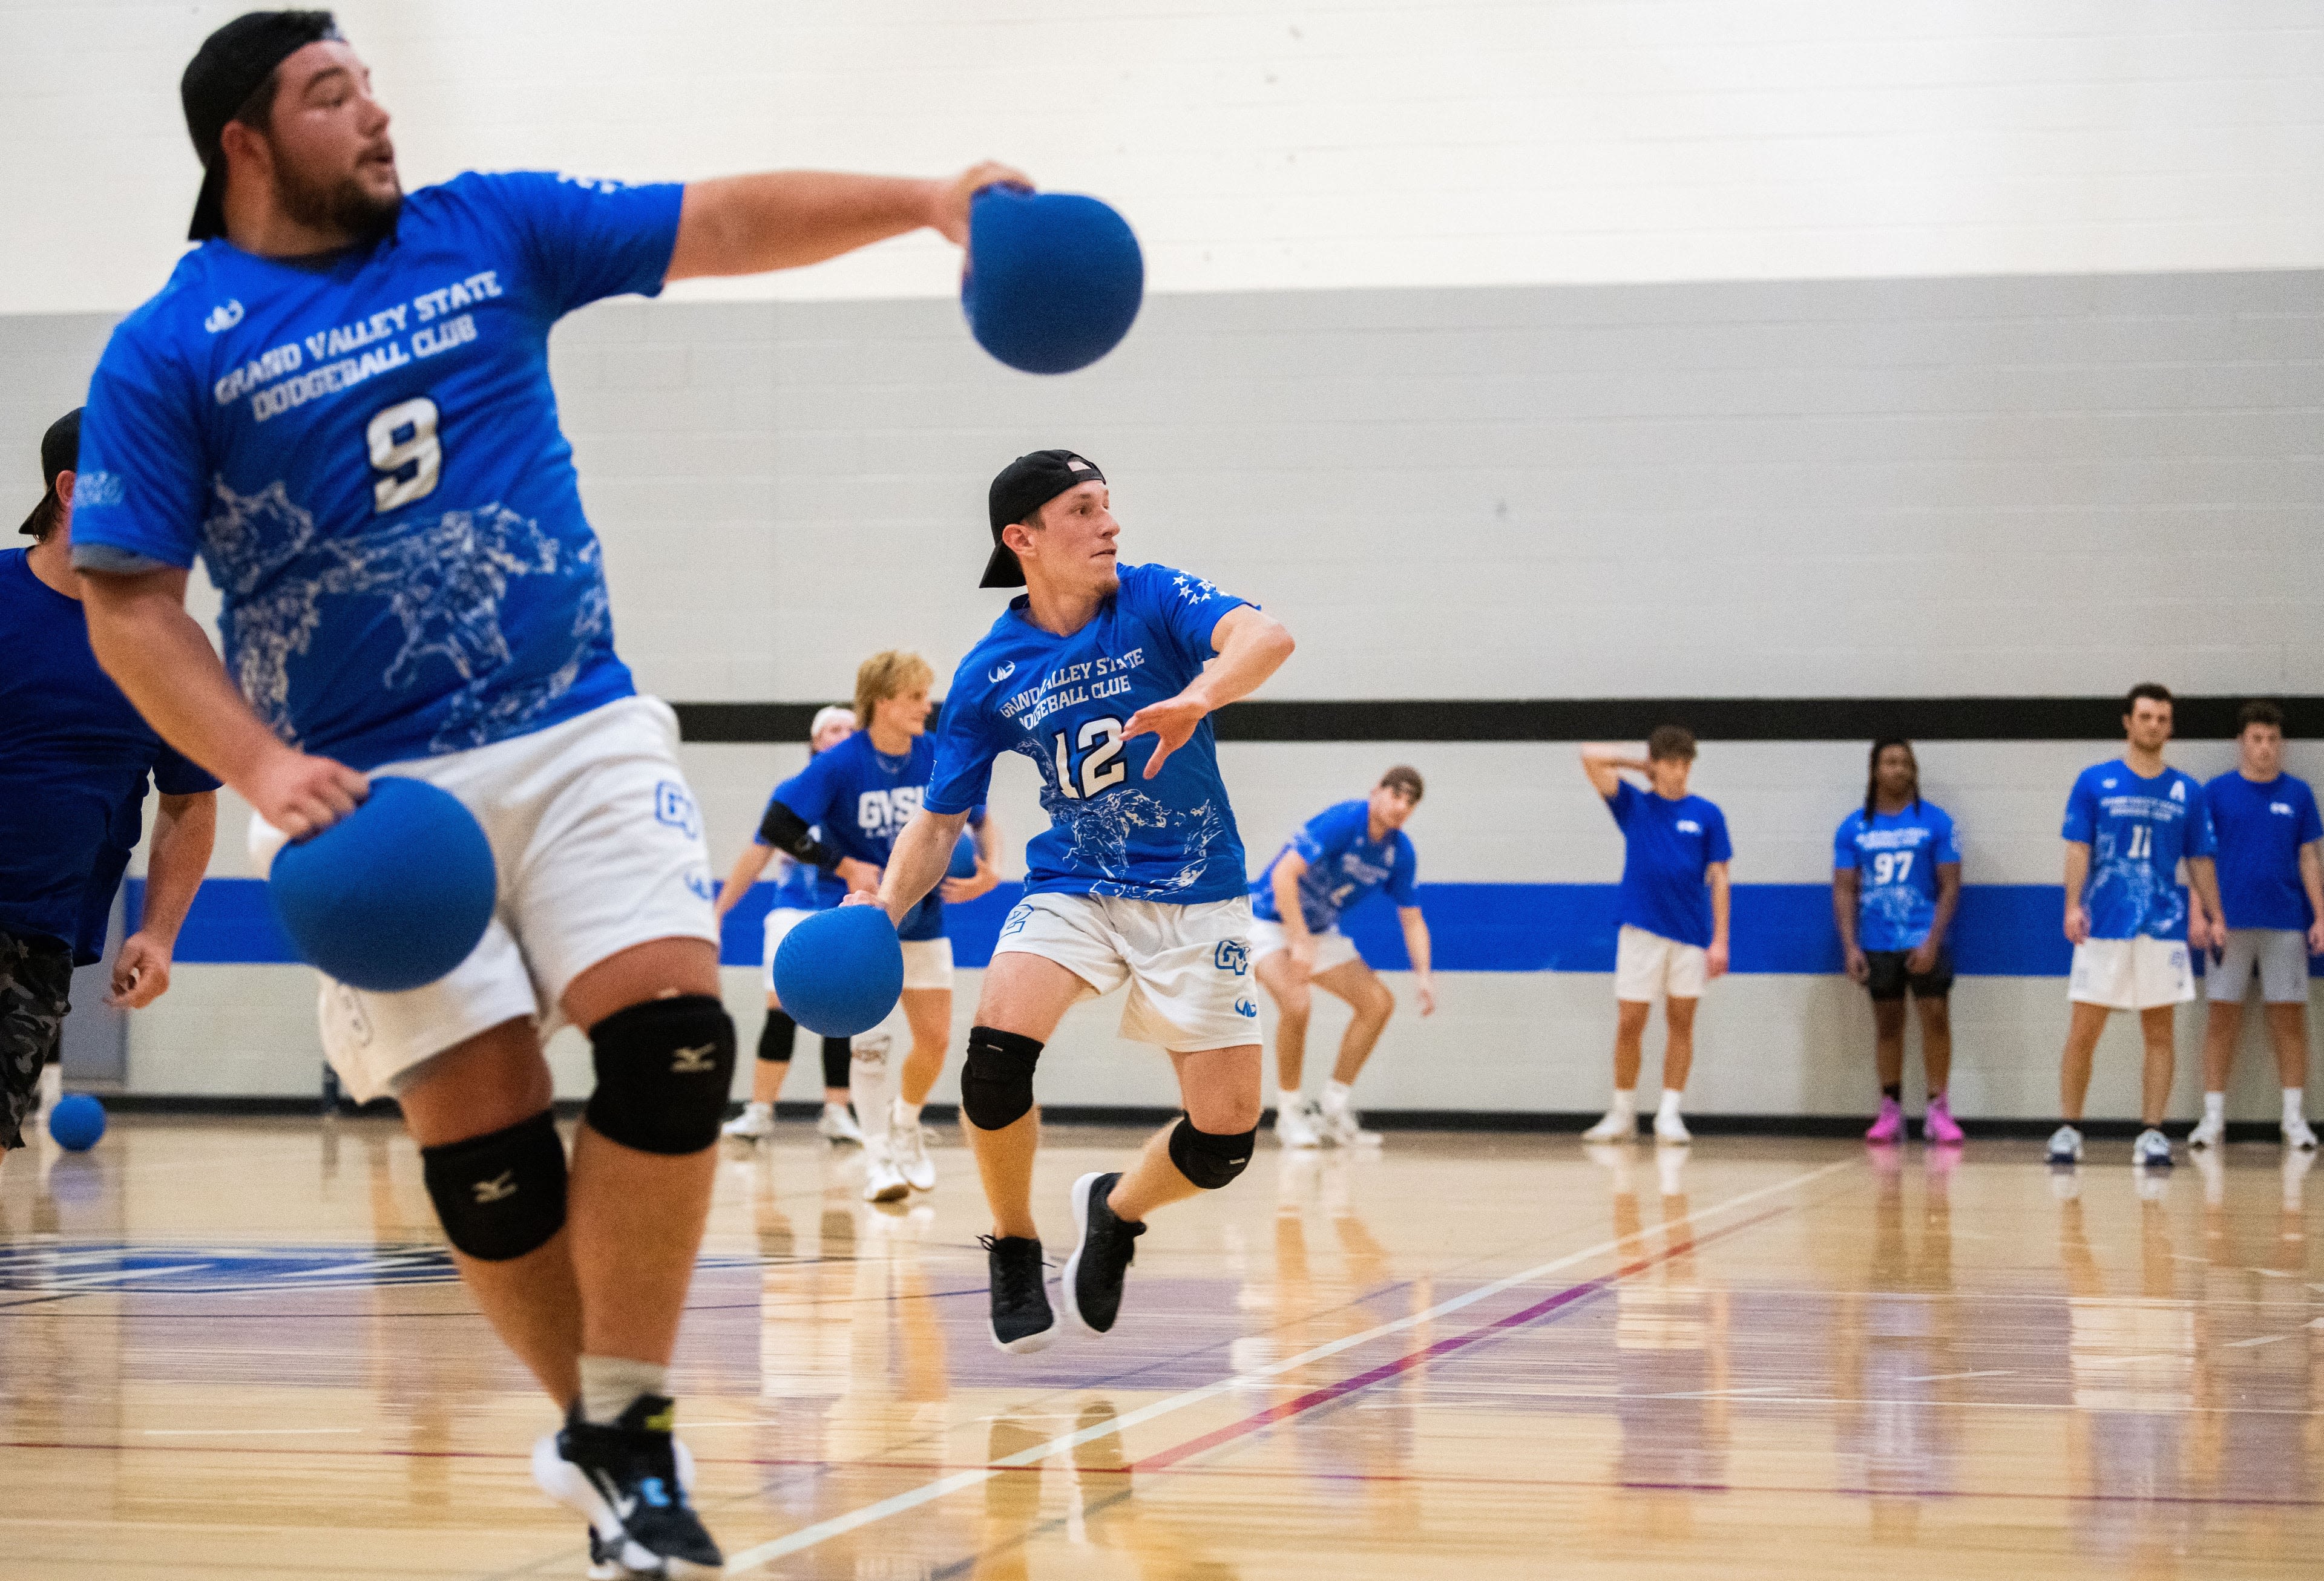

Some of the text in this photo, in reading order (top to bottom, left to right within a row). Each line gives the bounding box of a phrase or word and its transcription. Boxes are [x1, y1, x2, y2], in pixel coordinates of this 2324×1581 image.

[215, 270, 503, 404] GRAND VALLEY STATE
[252, 313, 478, 422] DODGEBALL CLUB
[367, 397, 442, 514] 9
[1091, 675, 1132, 699] CLUB
[1096, 647, 1145, 676] STATE
[1054, 716, 1127, 800] 12
[1874, 849, 1914, 885] 97
